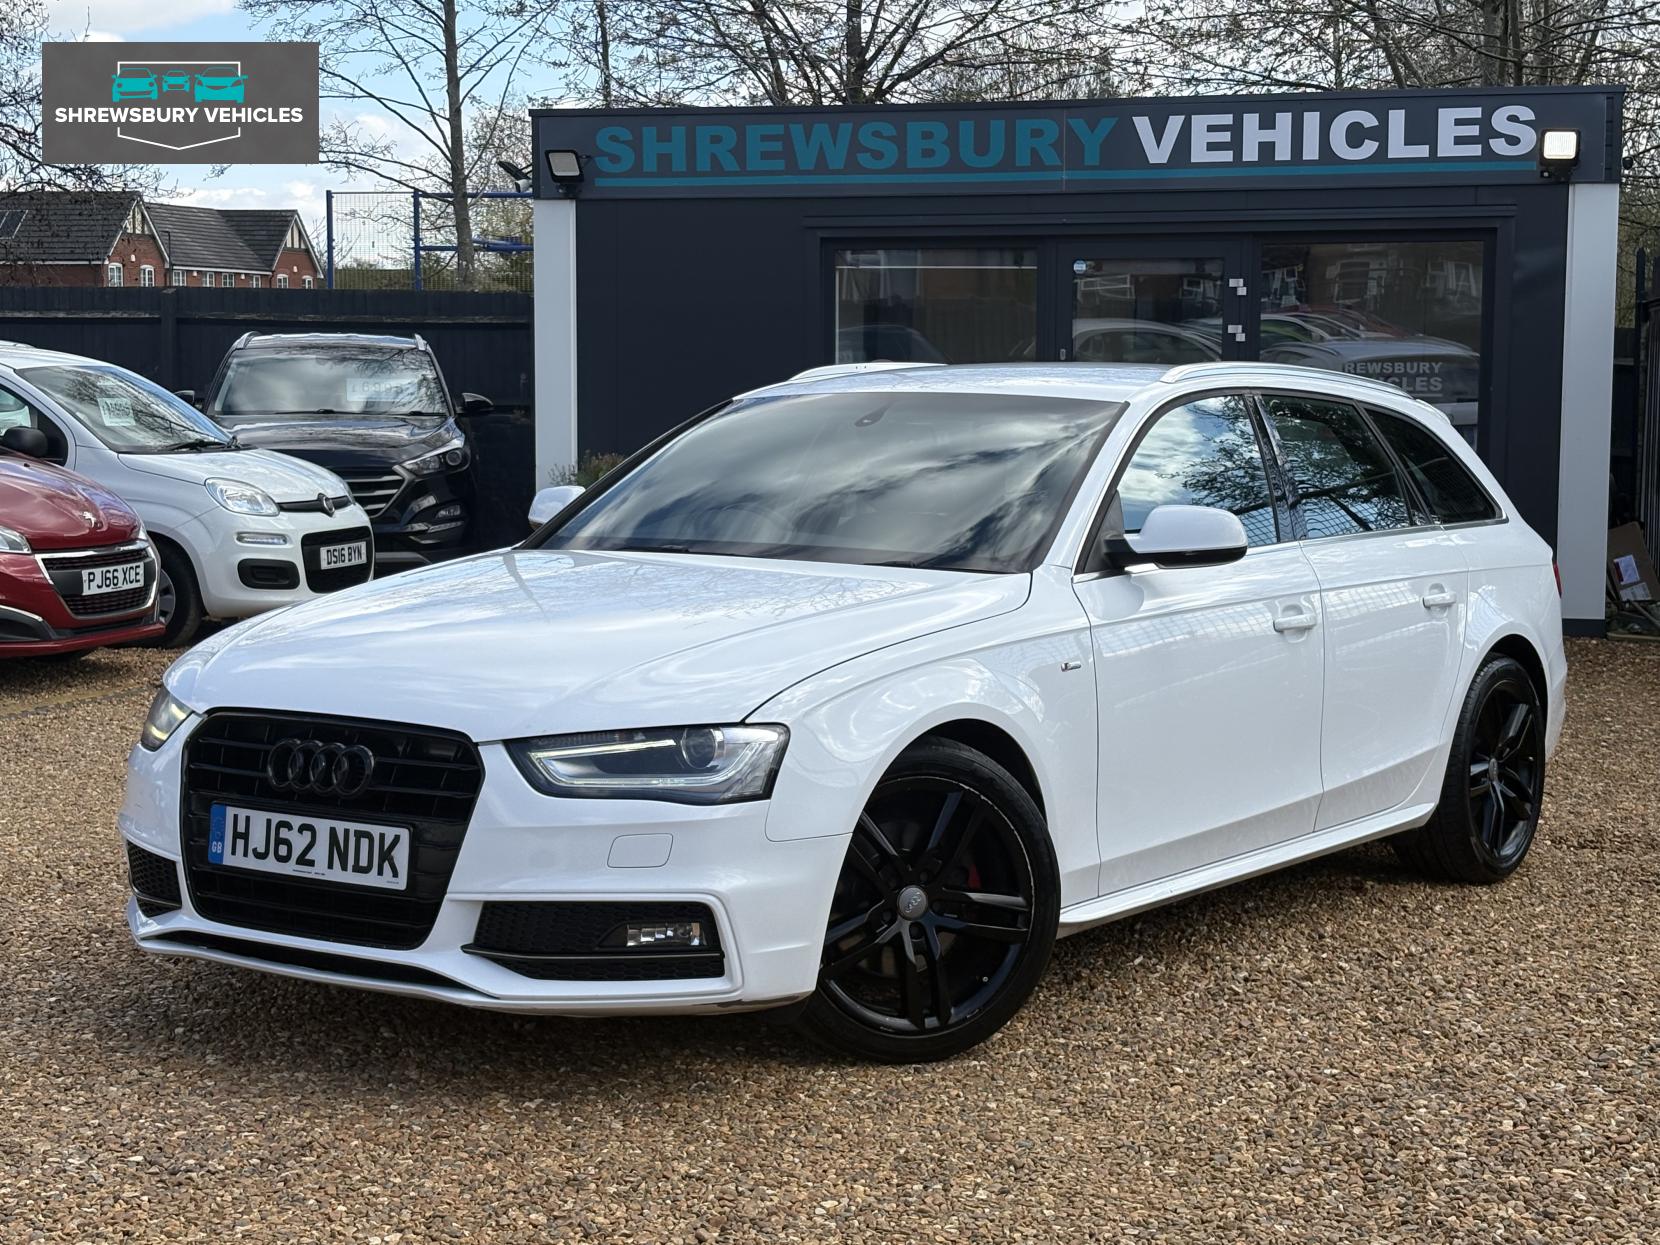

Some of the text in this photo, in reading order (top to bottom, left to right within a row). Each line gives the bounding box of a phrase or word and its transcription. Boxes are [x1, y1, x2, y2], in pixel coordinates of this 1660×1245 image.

[593, 105, 1537, 173] SHREWSBURY VEHICLES
[1341, 362, 1443, 374] REWSBURY
[327, 544, 362, 565] DS16 BYN
[87, 564, 141, 591] PJ66 XCE
[211, 841, 223, 854] GB
[230, 813, 401, 879] HJ62 NDK
